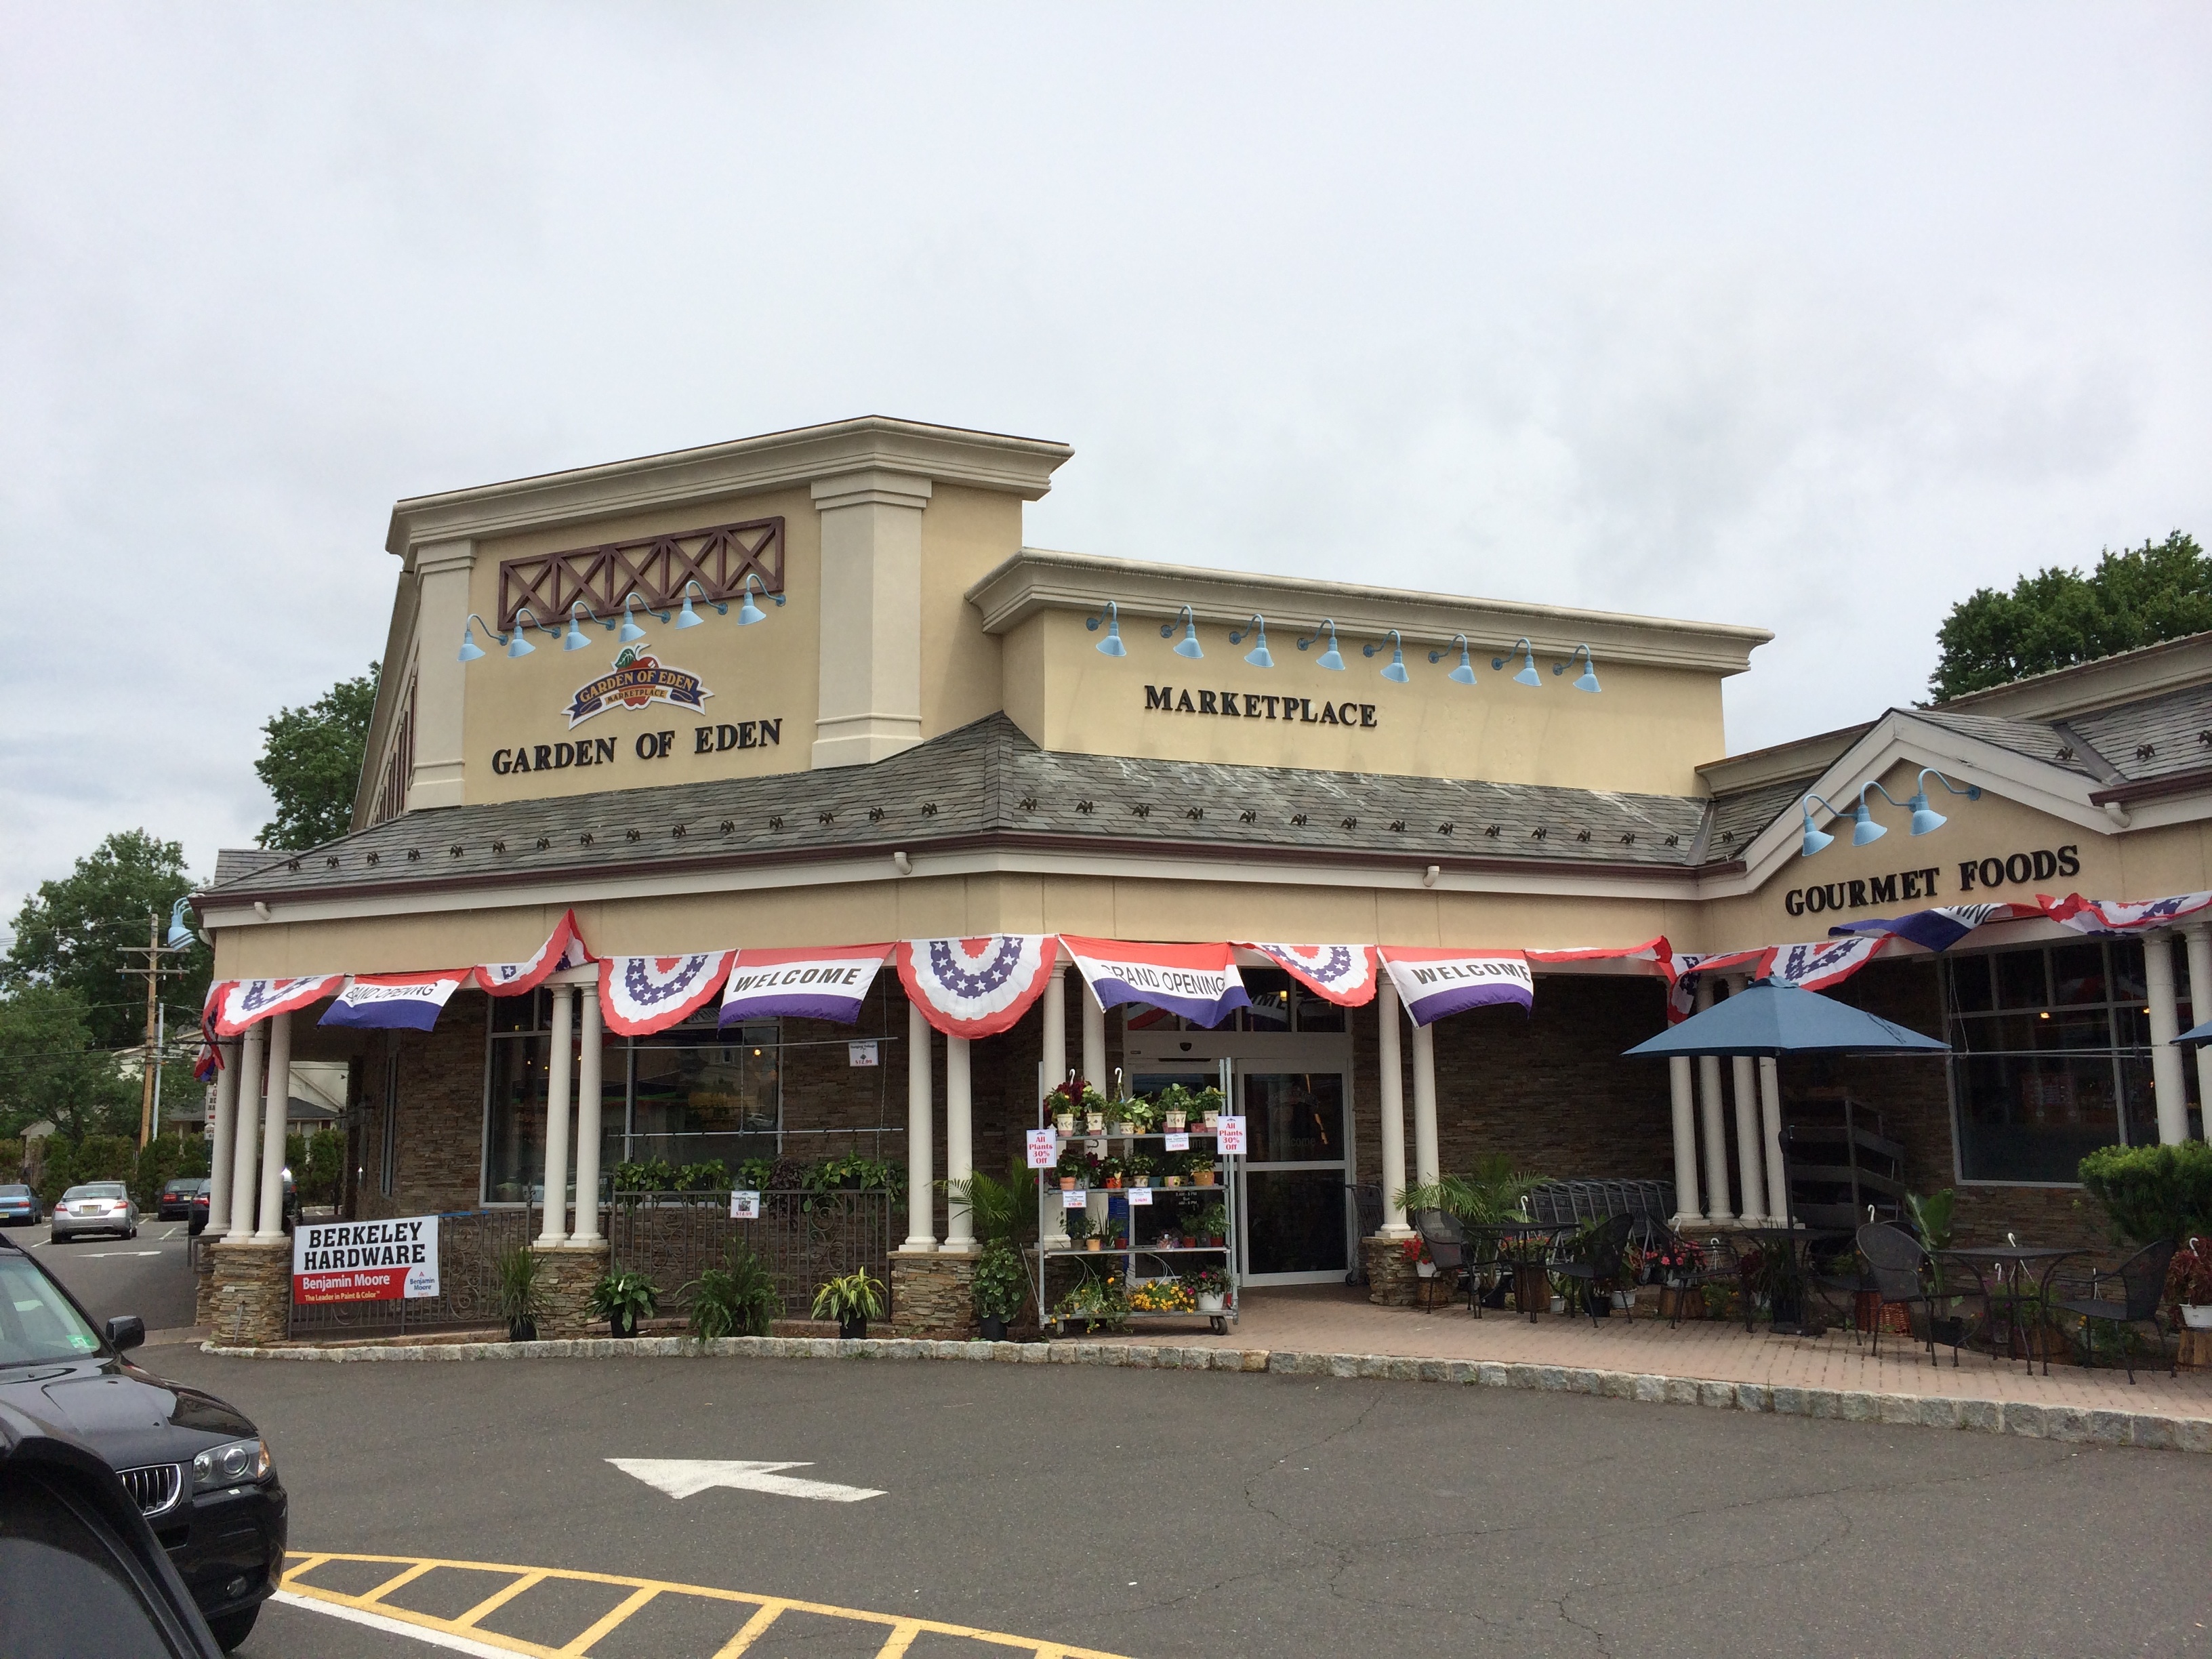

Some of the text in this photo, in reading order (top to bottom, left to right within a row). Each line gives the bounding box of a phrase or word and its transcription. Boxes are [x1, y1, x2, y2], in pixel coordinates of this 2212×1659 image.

[579, 670, 695, 703] GARDEN OF EDEN
[606, 689, 666, 705] MARKETPLACE
[1144, 684, 1378, 727] MARKETPLACE
[491, 718, 783, 775] GARDEN OF EDEN
[1784, 844, 2081, 917] GOURMET FOODS
[732, 967, 863, 994] WELCOME
[1162, 971, 1225, 996] OPENING
[1410, 963, 1531, 985] WELCOME
[308, 1221, 423, 1249] BERKELEY
[304, 1244, 426, 1271] HARDWARE
[302, 1273, 390, 1292] Benjamin Moore
[409, 1277, 435, 1285] Benjamin
[315, 1293, 333, 1301] Leader
